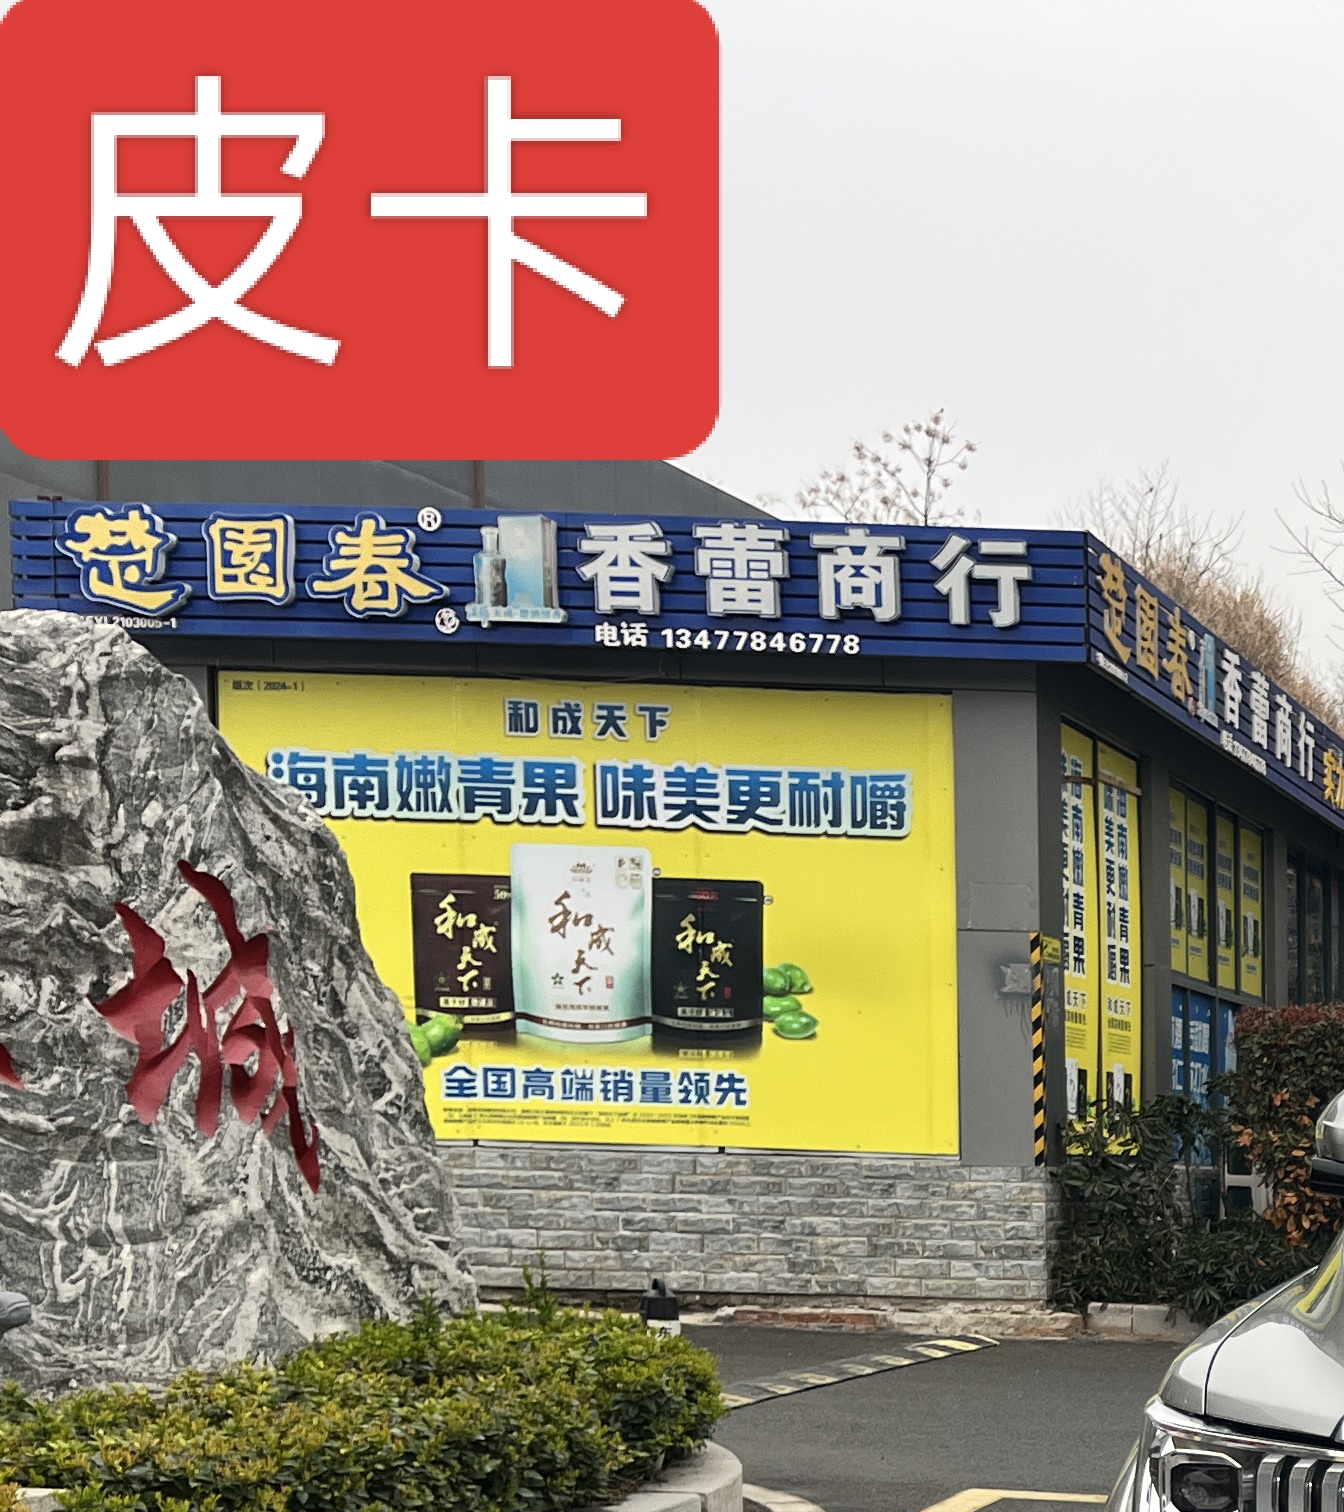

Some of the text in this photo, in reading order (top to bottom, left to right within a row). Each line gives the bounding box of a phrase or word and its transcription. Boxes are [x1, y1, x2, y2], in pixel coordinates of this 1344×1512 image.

[576, 521, 1032, 627] 香蕾商行
[594, 621, 861, 655] 电话 13477846778
[505, 697, 673, 741] 和成天下
[265, 748, 912, 839] 海南嫩青果 味美更耐嚼
[443, 1065, 748, 1106] 全国高端销量领先
